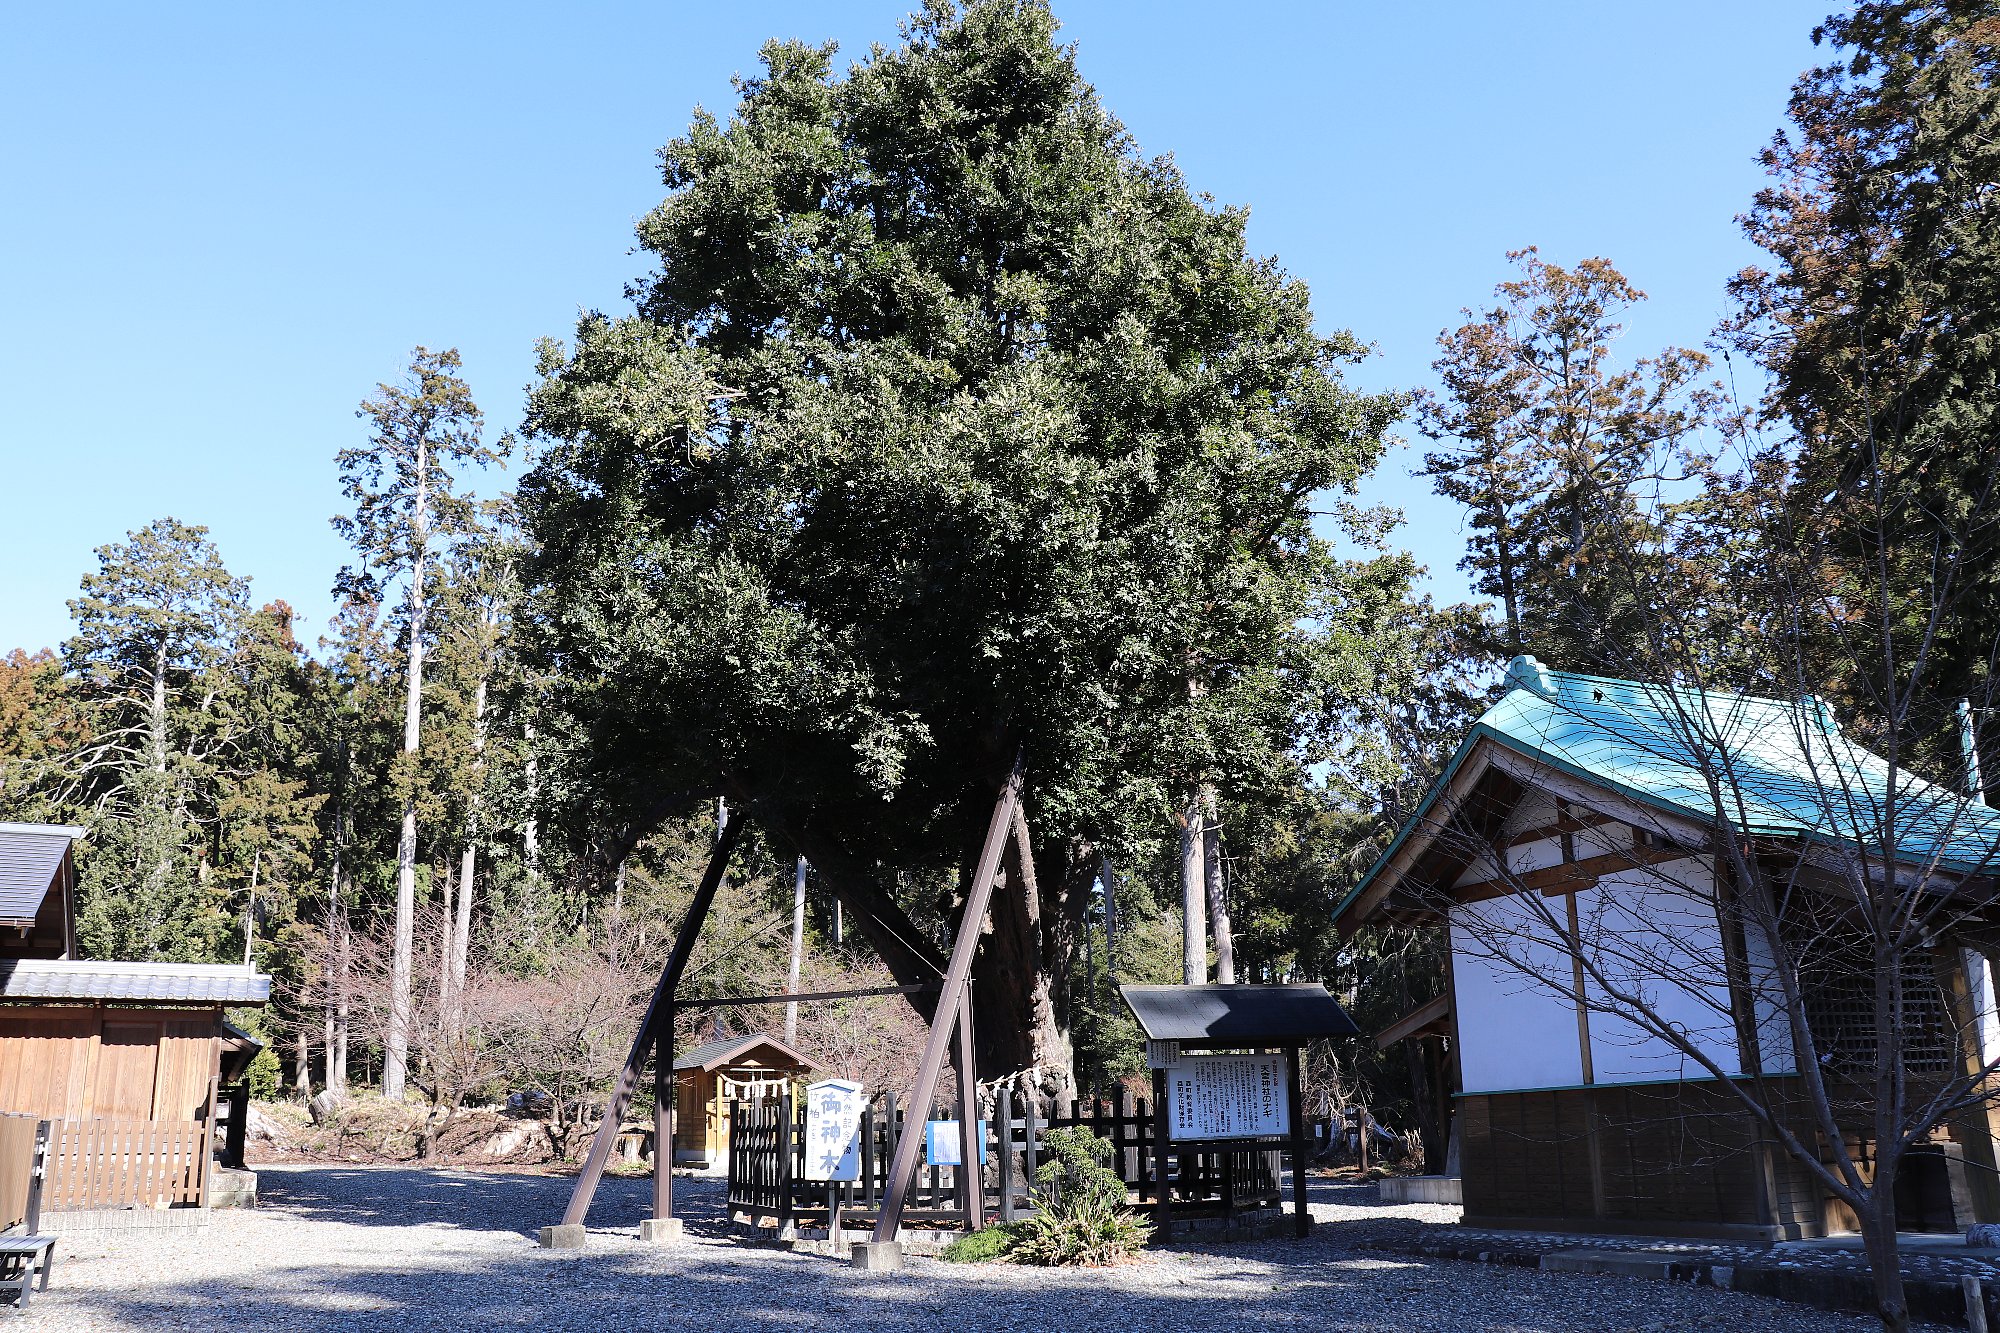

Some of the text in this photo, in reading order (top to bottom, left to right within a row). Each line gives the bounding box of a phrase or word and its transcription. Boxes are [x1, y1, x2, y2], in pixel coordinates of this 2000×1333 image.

[820, 1091, 841, 1173] 御神木
[842, 1093, 852, 1154] 天然記念物
